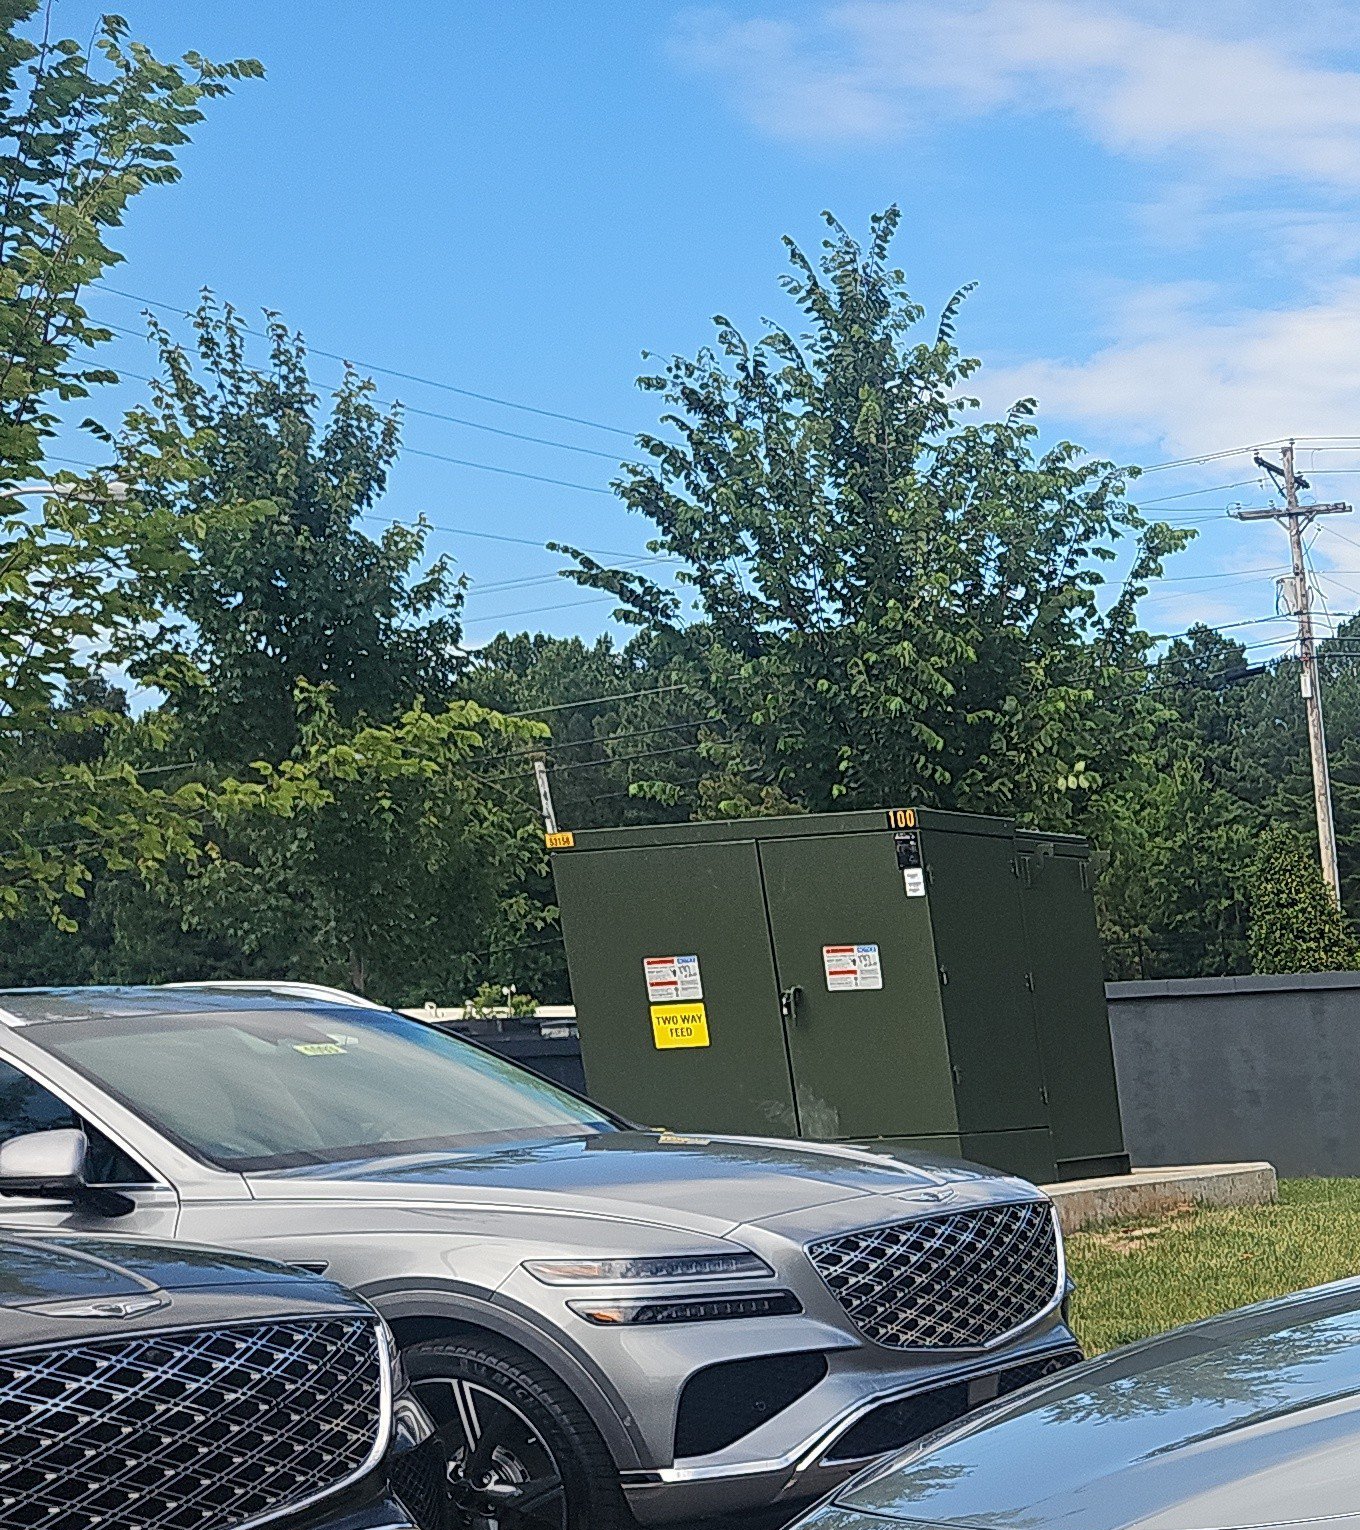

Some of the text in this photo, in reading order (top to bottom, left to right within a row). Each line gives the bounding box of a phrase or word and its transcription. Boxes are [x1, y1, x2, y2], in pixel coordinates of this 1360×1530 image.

[888, 809, 916, 829] 100
[655, 1013, 703, 1026] TWO WAY
[669, 1026, 693, 1038] FEED
